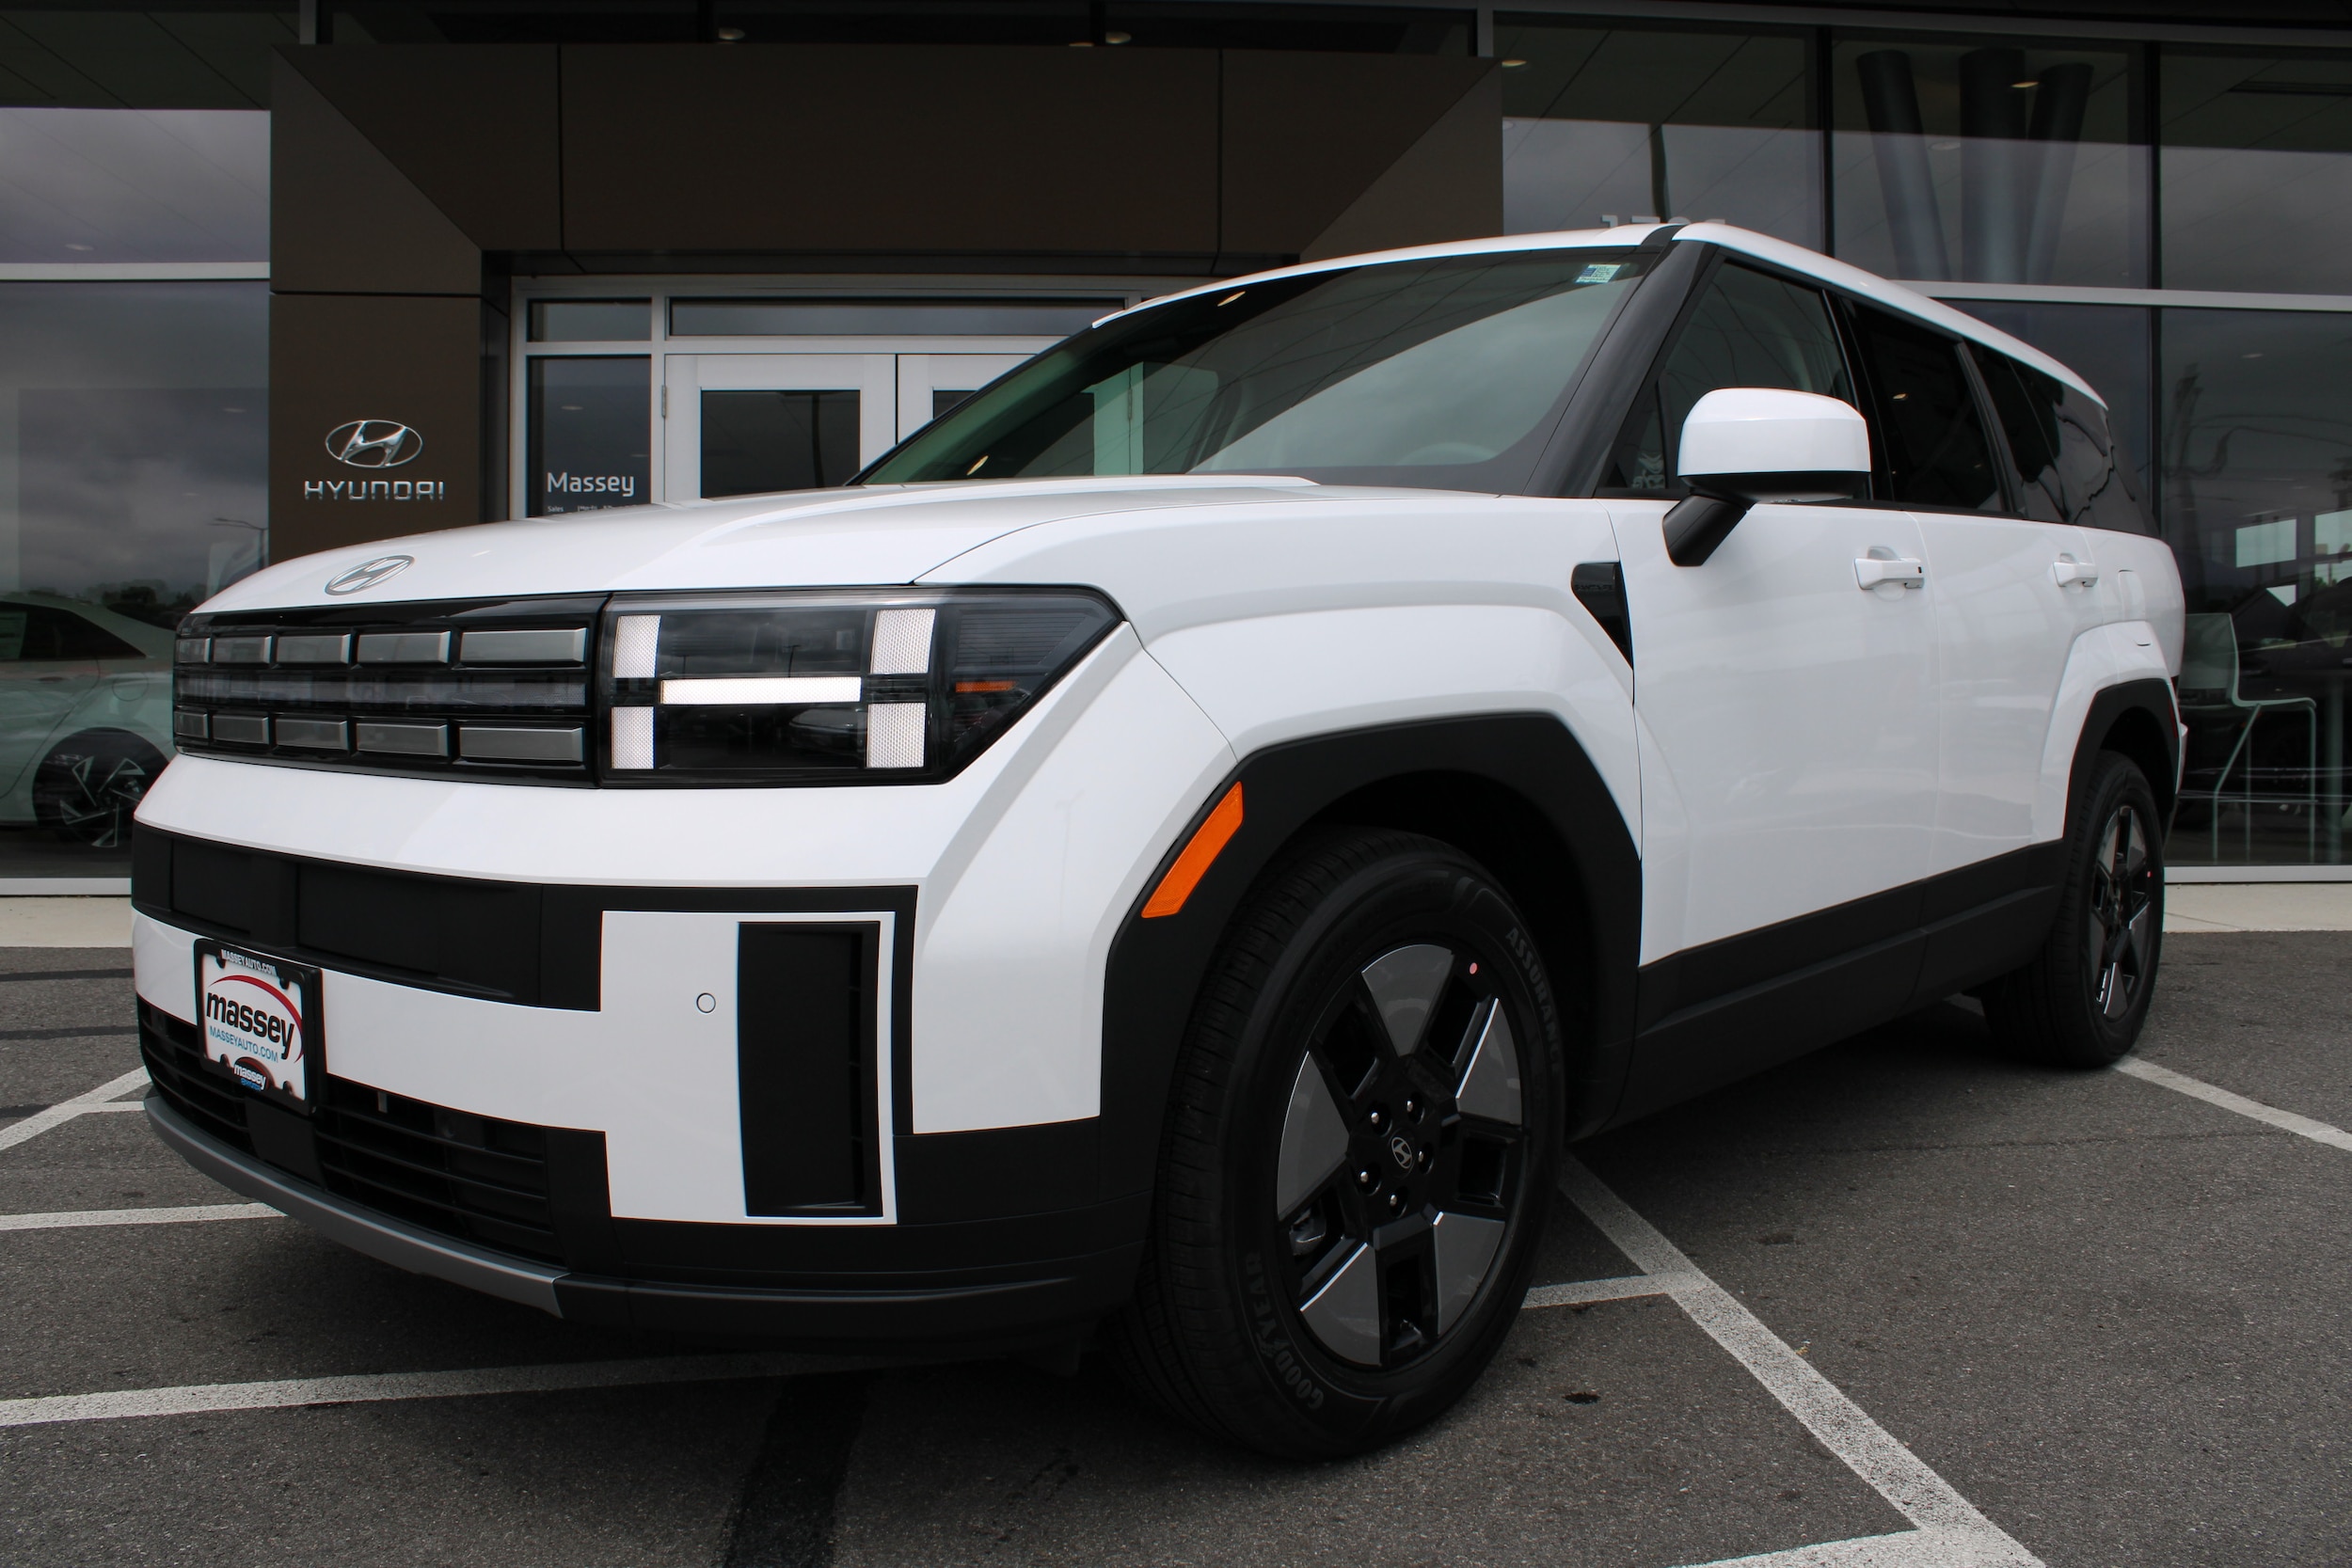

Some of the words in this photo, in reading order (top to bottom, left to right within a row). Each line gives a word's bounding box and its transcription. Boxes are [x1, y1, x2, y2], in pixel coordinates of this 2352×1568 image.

[305, 480, 444, 501] HYUNDAI
[547, 471, 635, 498] Massey
[220, 948, 278, 976] MASSEYAUTO.COM
[1505, 927, 1563, 1077] ASSURANCE
[206, 991, 295, 1060] massey
[210, 1025, 278, 1063] MASSEYAUTO.COM
[233, 1064, 267, 1090] massey
[1246, 1249, 1325, 1410] GOODYEAR
